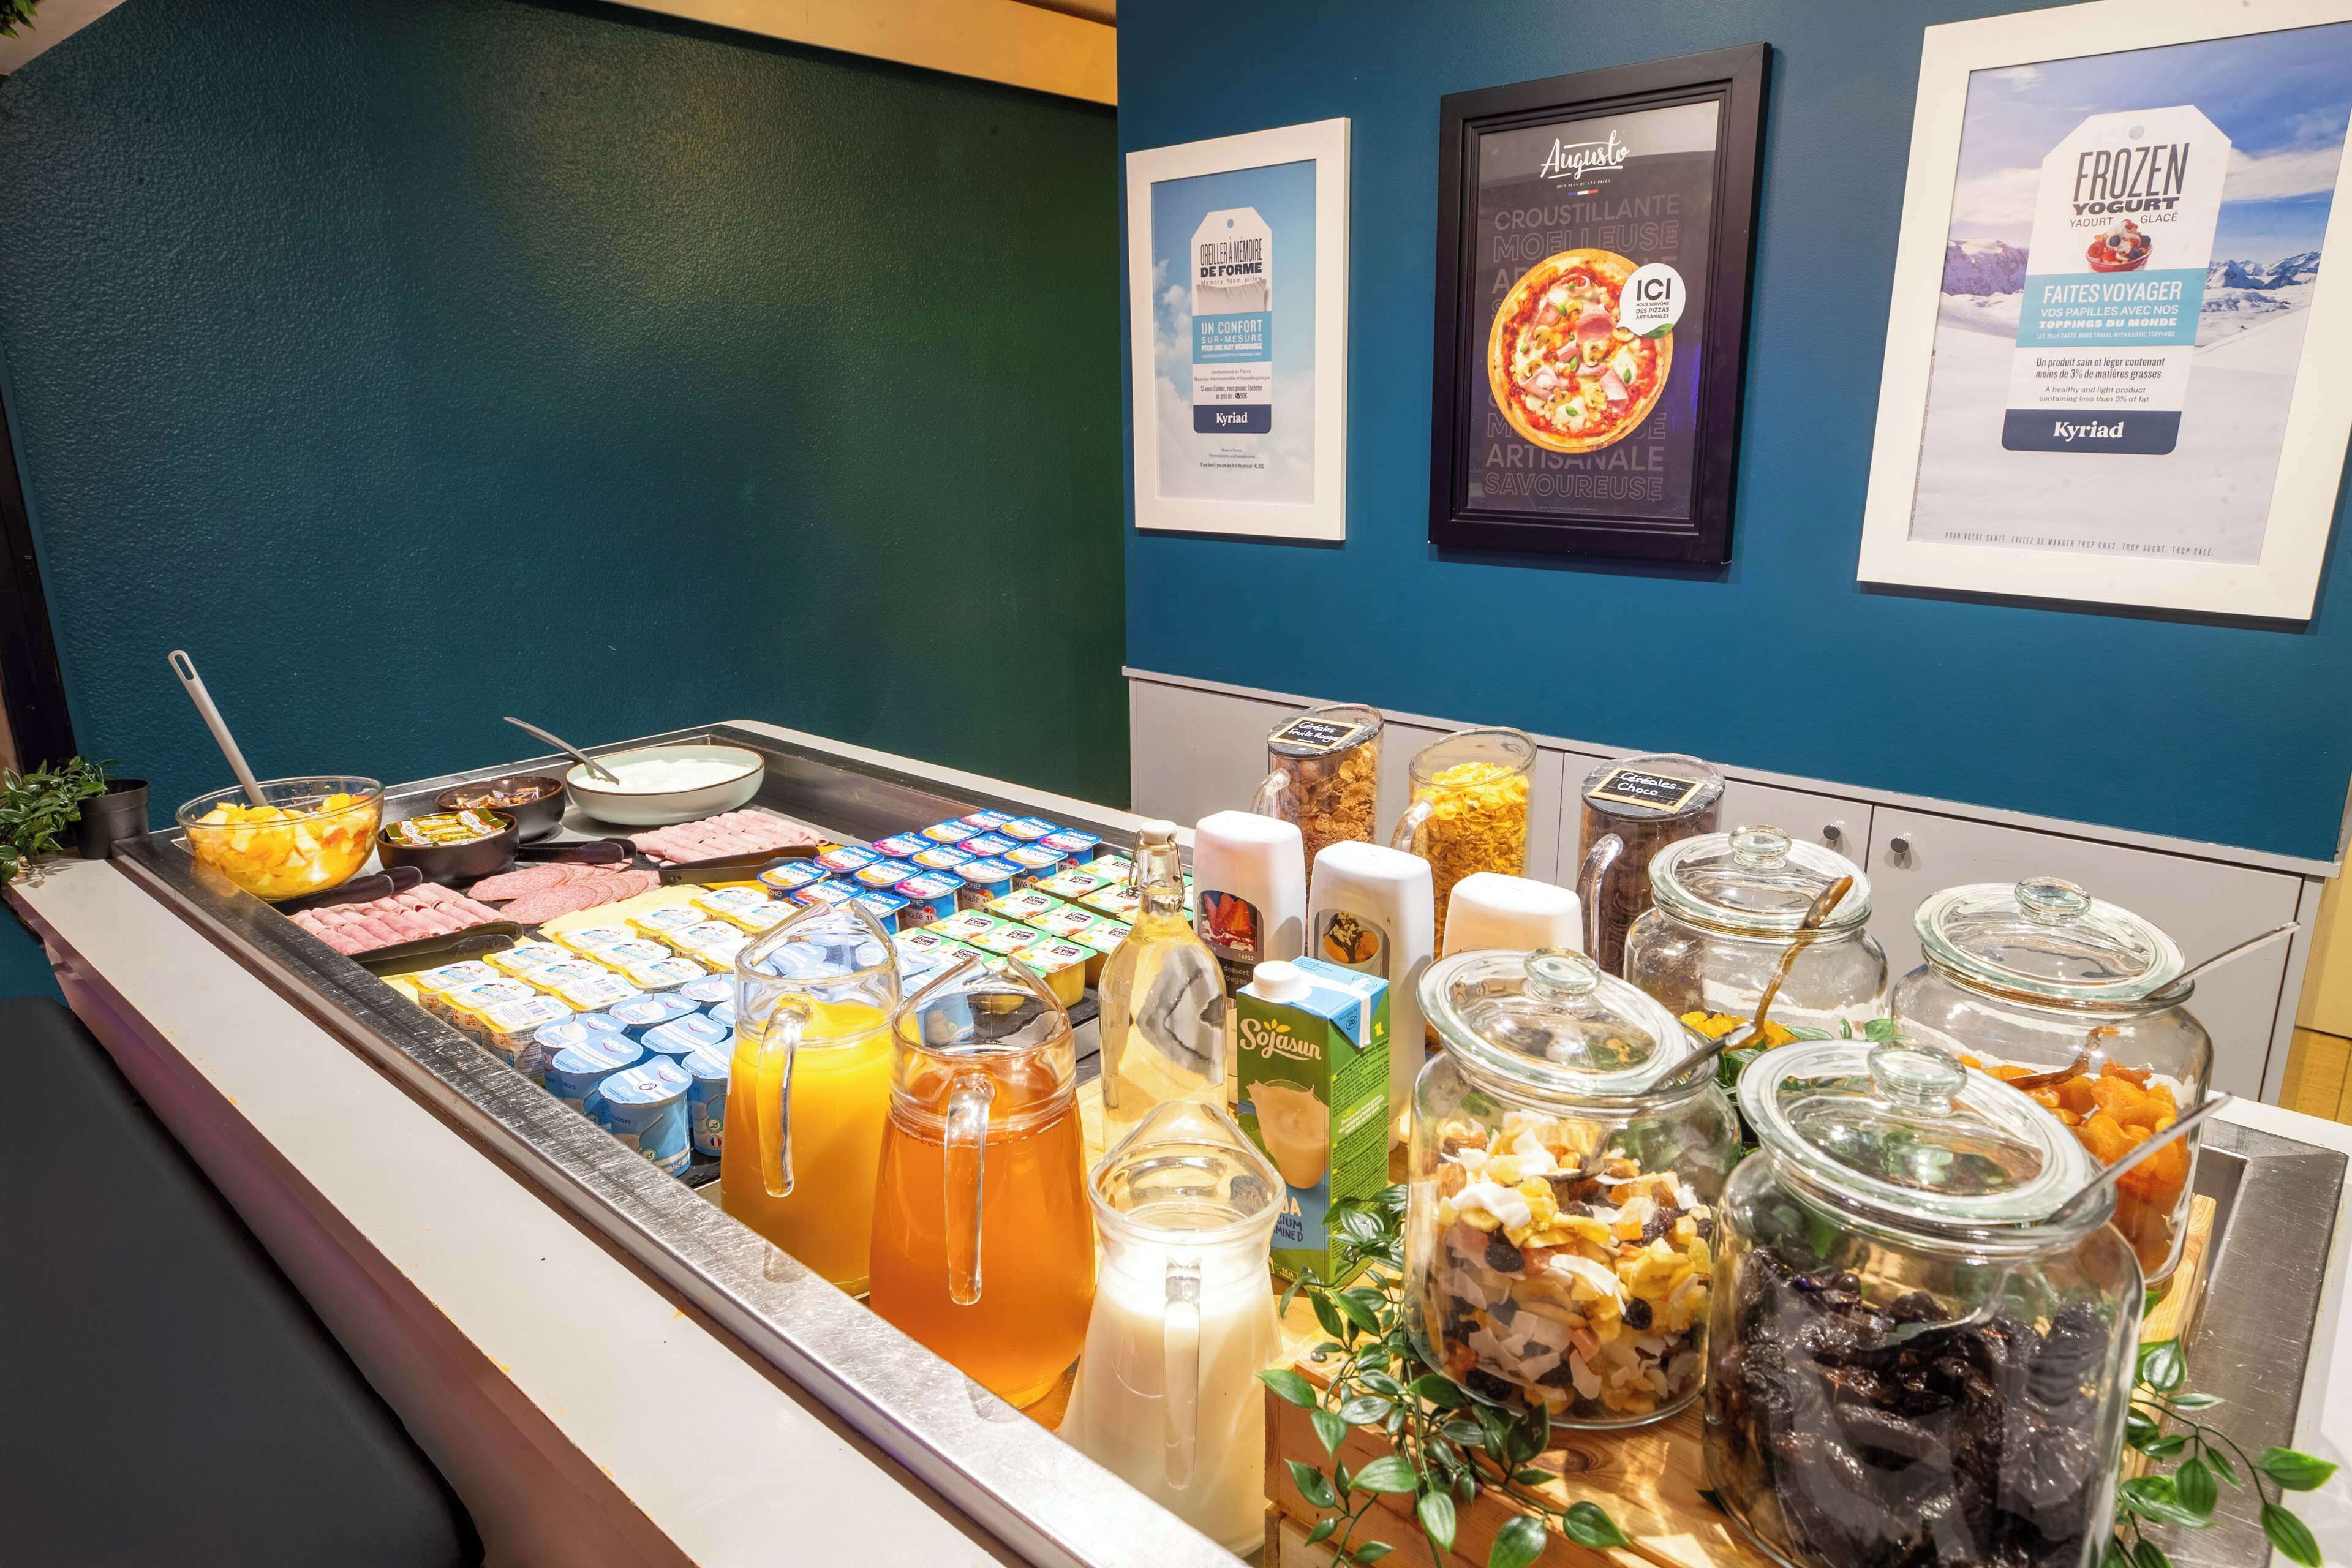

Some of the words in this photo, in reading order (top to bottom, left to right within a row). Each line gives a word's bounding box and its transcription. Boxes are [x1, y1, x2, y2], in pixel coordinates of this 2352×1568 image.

[1540, 130, 1630, 180] Augusto
[2073, 142, 2190, 202] FROZEN
[1494, 194, 1680, 231] CROUSTILLANTE
[2072, 197, 2180, 216] YOGURT
[2070, 217, 2114, 228] YAOURT
[2140, 211, 2178, 224] GLACÉ
[1200, 243, 1227, 266] OREILLER
[1234, 236, 1262, 263] MÉMOIRE
[1200, 266, 1216, 278] DE
[1219, 262, 1262, 277] FORME
[1637, 278, 1671, 301] ICI
[2043, 284, 2100, 304] FAITES
[2102, 281, 2183, 303] VOYAGER
[2041, 308, 2063, 317] VOS
[2065, 306, 2119, 317] PAPILLES
[2120, 306, 2151, 315] AVEC
[2154, 305, 2179, 314] NOS
[1201, 323, 1214, 334] UN
[1218, 320, 1262, 334] CONFORT
[2039, 319, 2103, 329] TOPPINGS
[2106, 319, 2124, 328] DU
[2128, 318, 2177, 327] MONDE
[1201, 334, 1263, 344] SUR-MESURE
[2036, 358, 2046, 367] Un
[2048, 358, 2075, 368] produit
[2077, 358, 2092, 366] sain
[2094, 358, 2101, 366] et
[2103, 357, 2123, 368] léger
[2125, 358, 2165, 367] contenant
[2036, 369, 2057, 378] moins
[2059, 369, 2068, 378] de
[2070, 369, 2082, 378] 3%
[2084, 369, 2094, 378] de
[2095, 368, 2129, 378] matières
[2130, 371, 2161, 380] grasses
[1216, 412, 1248, 426] Kyriad
[2053, 420, 2125, 442] Kyriad
[1485, 443, 1665, 472] ARTISANALE
[1485, 472, 1664, 501] SAVOUREUSE
[2048, 538, 2075, 547] MANGER
[2078, 540, 2095, 548] TROP
[2122, 543, 2139, 551] TROP
[2172, 546, 2190, 554] TROP
[1289, 728, 1313, 737] Fruits
[1618, 782, 1659, 796] Choco
[1223, 965, 1250, 976] dessert
[1374, 1022, 1384, 1036] 1L
[1240, 1018, 1321, 1061] Sojasun
[1297, 1231, 1303, 1242] D
